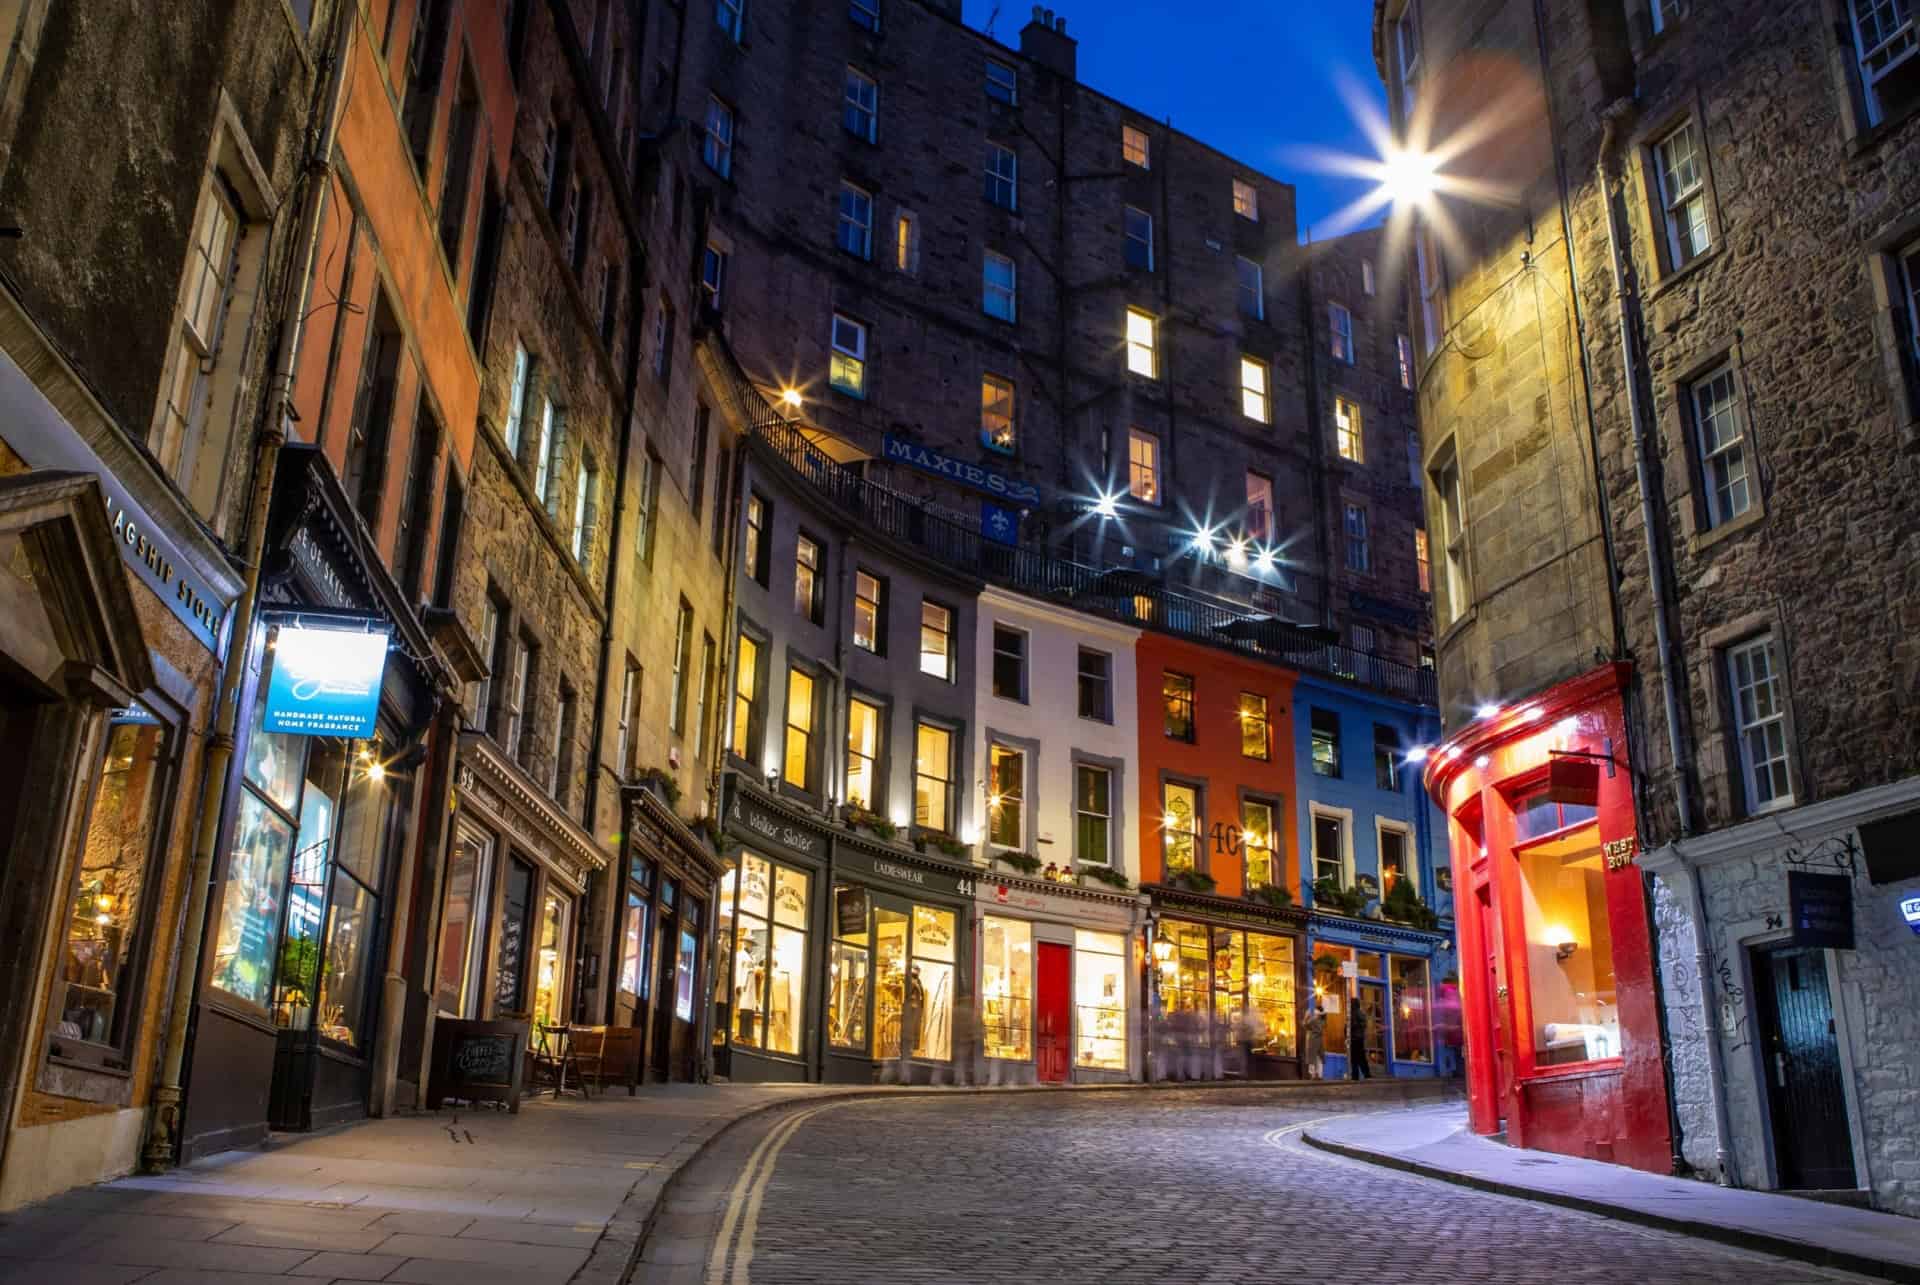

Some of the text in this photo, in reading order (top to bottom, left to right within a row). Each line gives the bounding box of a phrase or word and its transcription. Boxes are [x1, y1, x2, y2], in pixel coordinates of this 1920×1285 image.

[889, 439, 1007, 493] MAXIES
[178, 579, 220, 638] STORE
[273, 711, 366, 723] HANDMADE NATURAL
[278, 720, 360, 731] HOME FRAGRANCE
[1208, 822, 1239, 856] 40
[1603, 836, 1634, 869] WEST BOW
[873, 859, 924, 883] LADIESWEAR
[1766, 914, 1783, 930] 94
